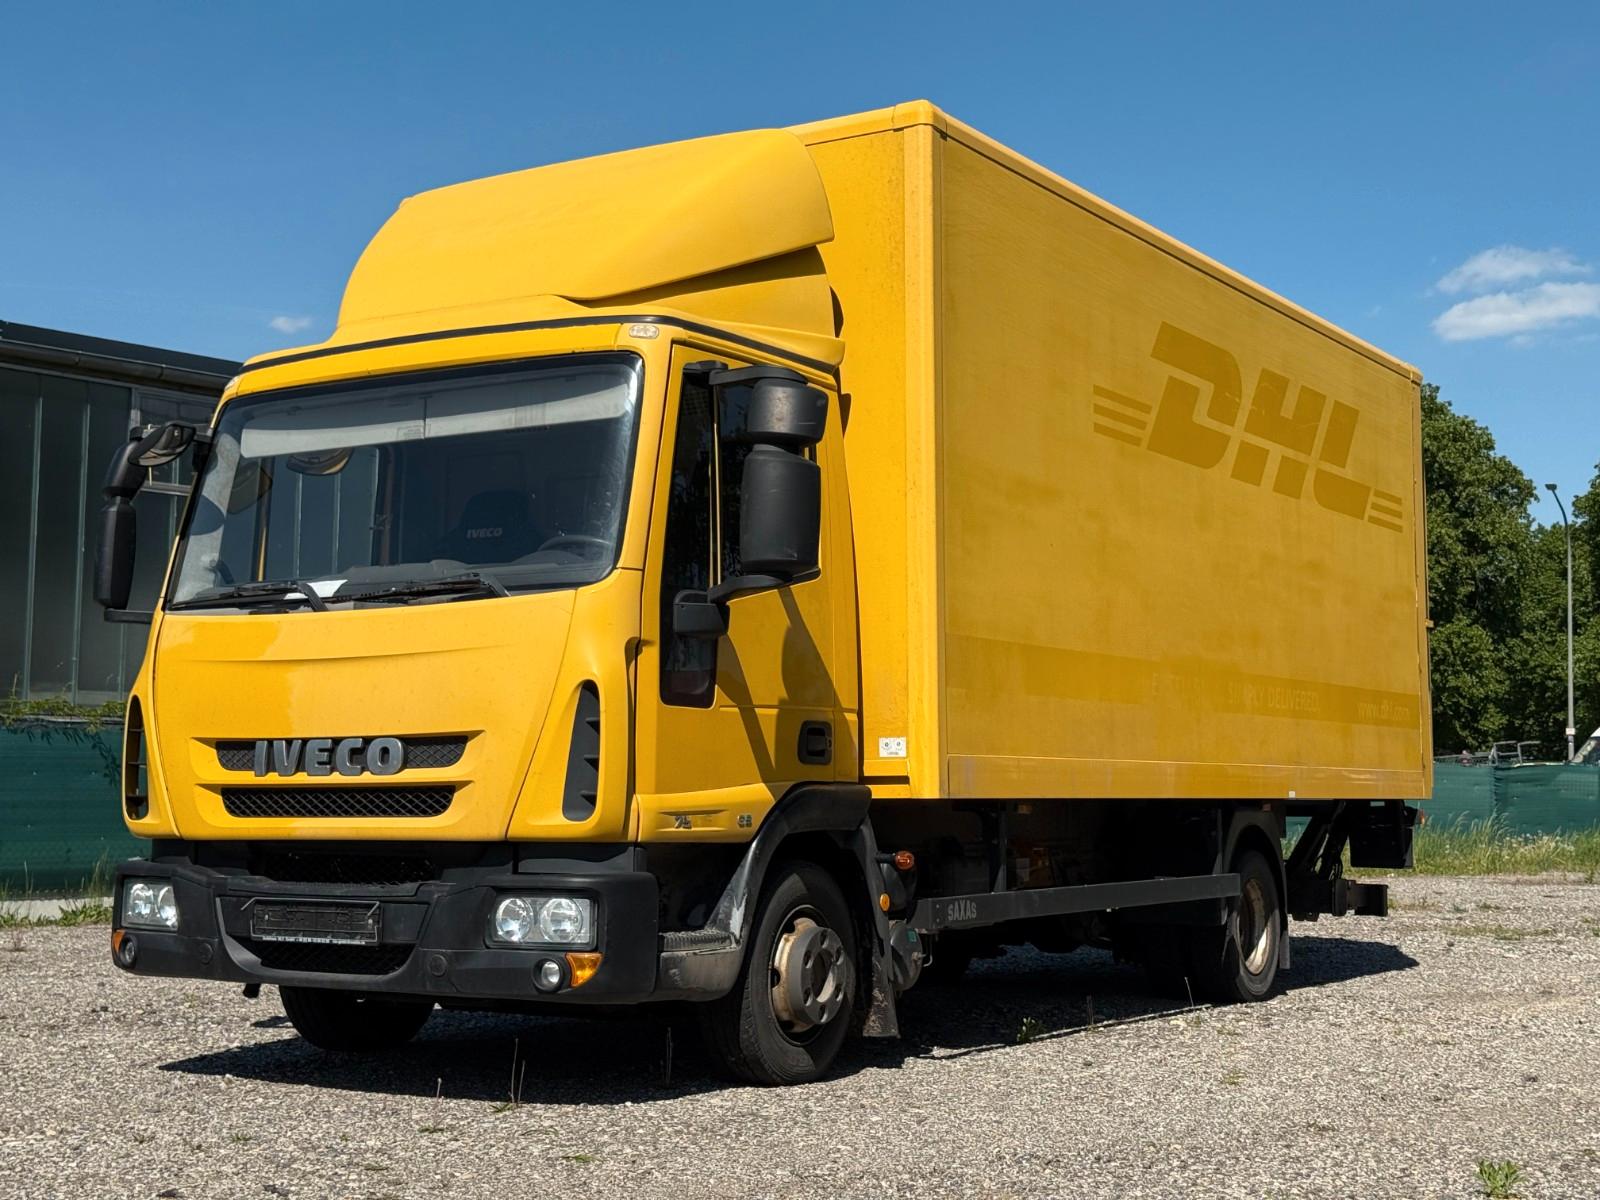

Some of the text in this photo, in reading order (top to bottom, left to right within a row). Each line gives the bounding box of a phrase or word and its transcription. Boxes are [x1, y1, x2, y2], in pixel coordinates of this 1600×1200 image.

[1146, 320, 1373, 521] DHL
[466, 527, 503, 539] IVECO
[254, 737, 404, 777] IVECO
[947, 899, 977, 921] SAXAS
